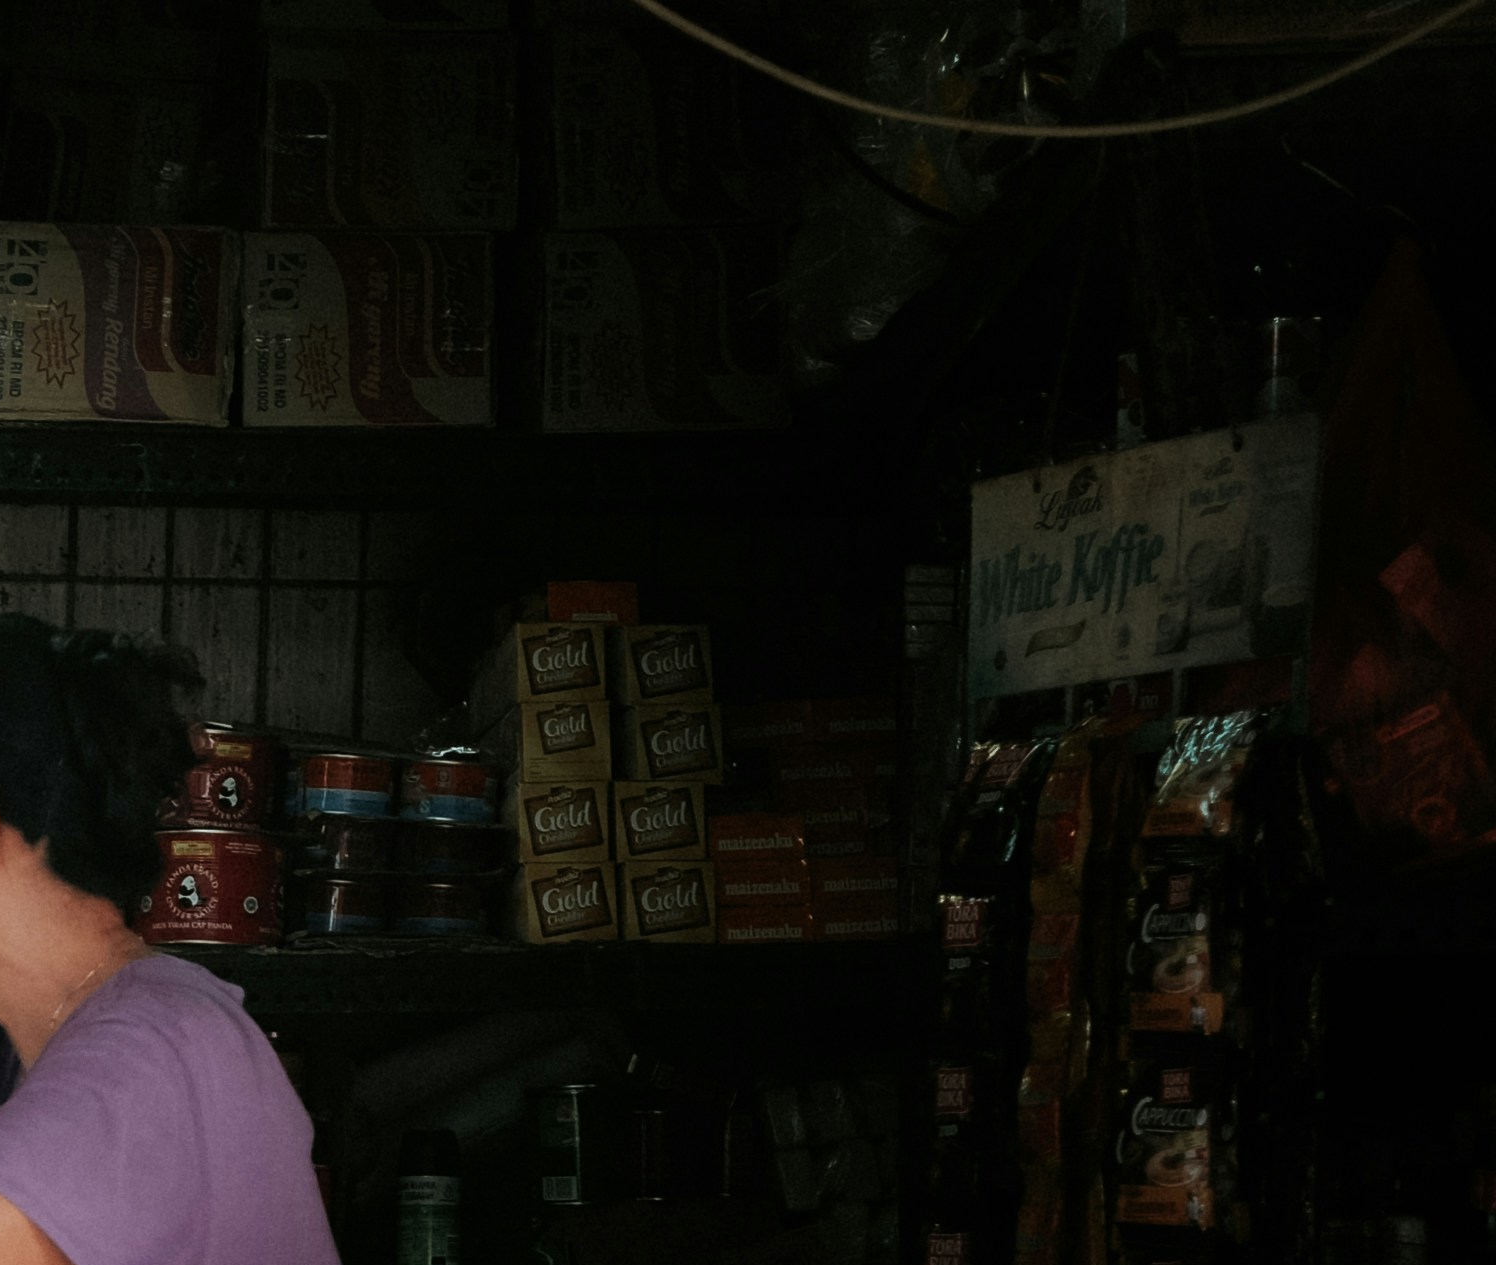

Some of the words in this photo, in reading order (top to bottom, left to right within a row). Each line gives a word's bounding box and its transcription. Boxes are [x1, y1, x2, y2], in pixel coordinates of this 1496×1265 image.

[96, 317, 124, 410] Rendang
[9, 376, 22, 398] MD
[978, 545, 1062, 629] White
[1066, 523, 1165, 614] Koffie
[532, 641, 589, 672] Gold
[641, 644, 698, 676] Gold
[543, 713, 588, 738] Gold
[651, 725, 707, 756] Gold
[534, 801, 592, 832] Gold
[630, 801, 687, 832] Gold
[166, 863, 192, 889] PANDA
[542, 880, 600, 914] Gold
[641, 881, 699, 913] Gold
[947, 905, 980, 922] TORA
[930, 1238, 963, 1255] TORA
